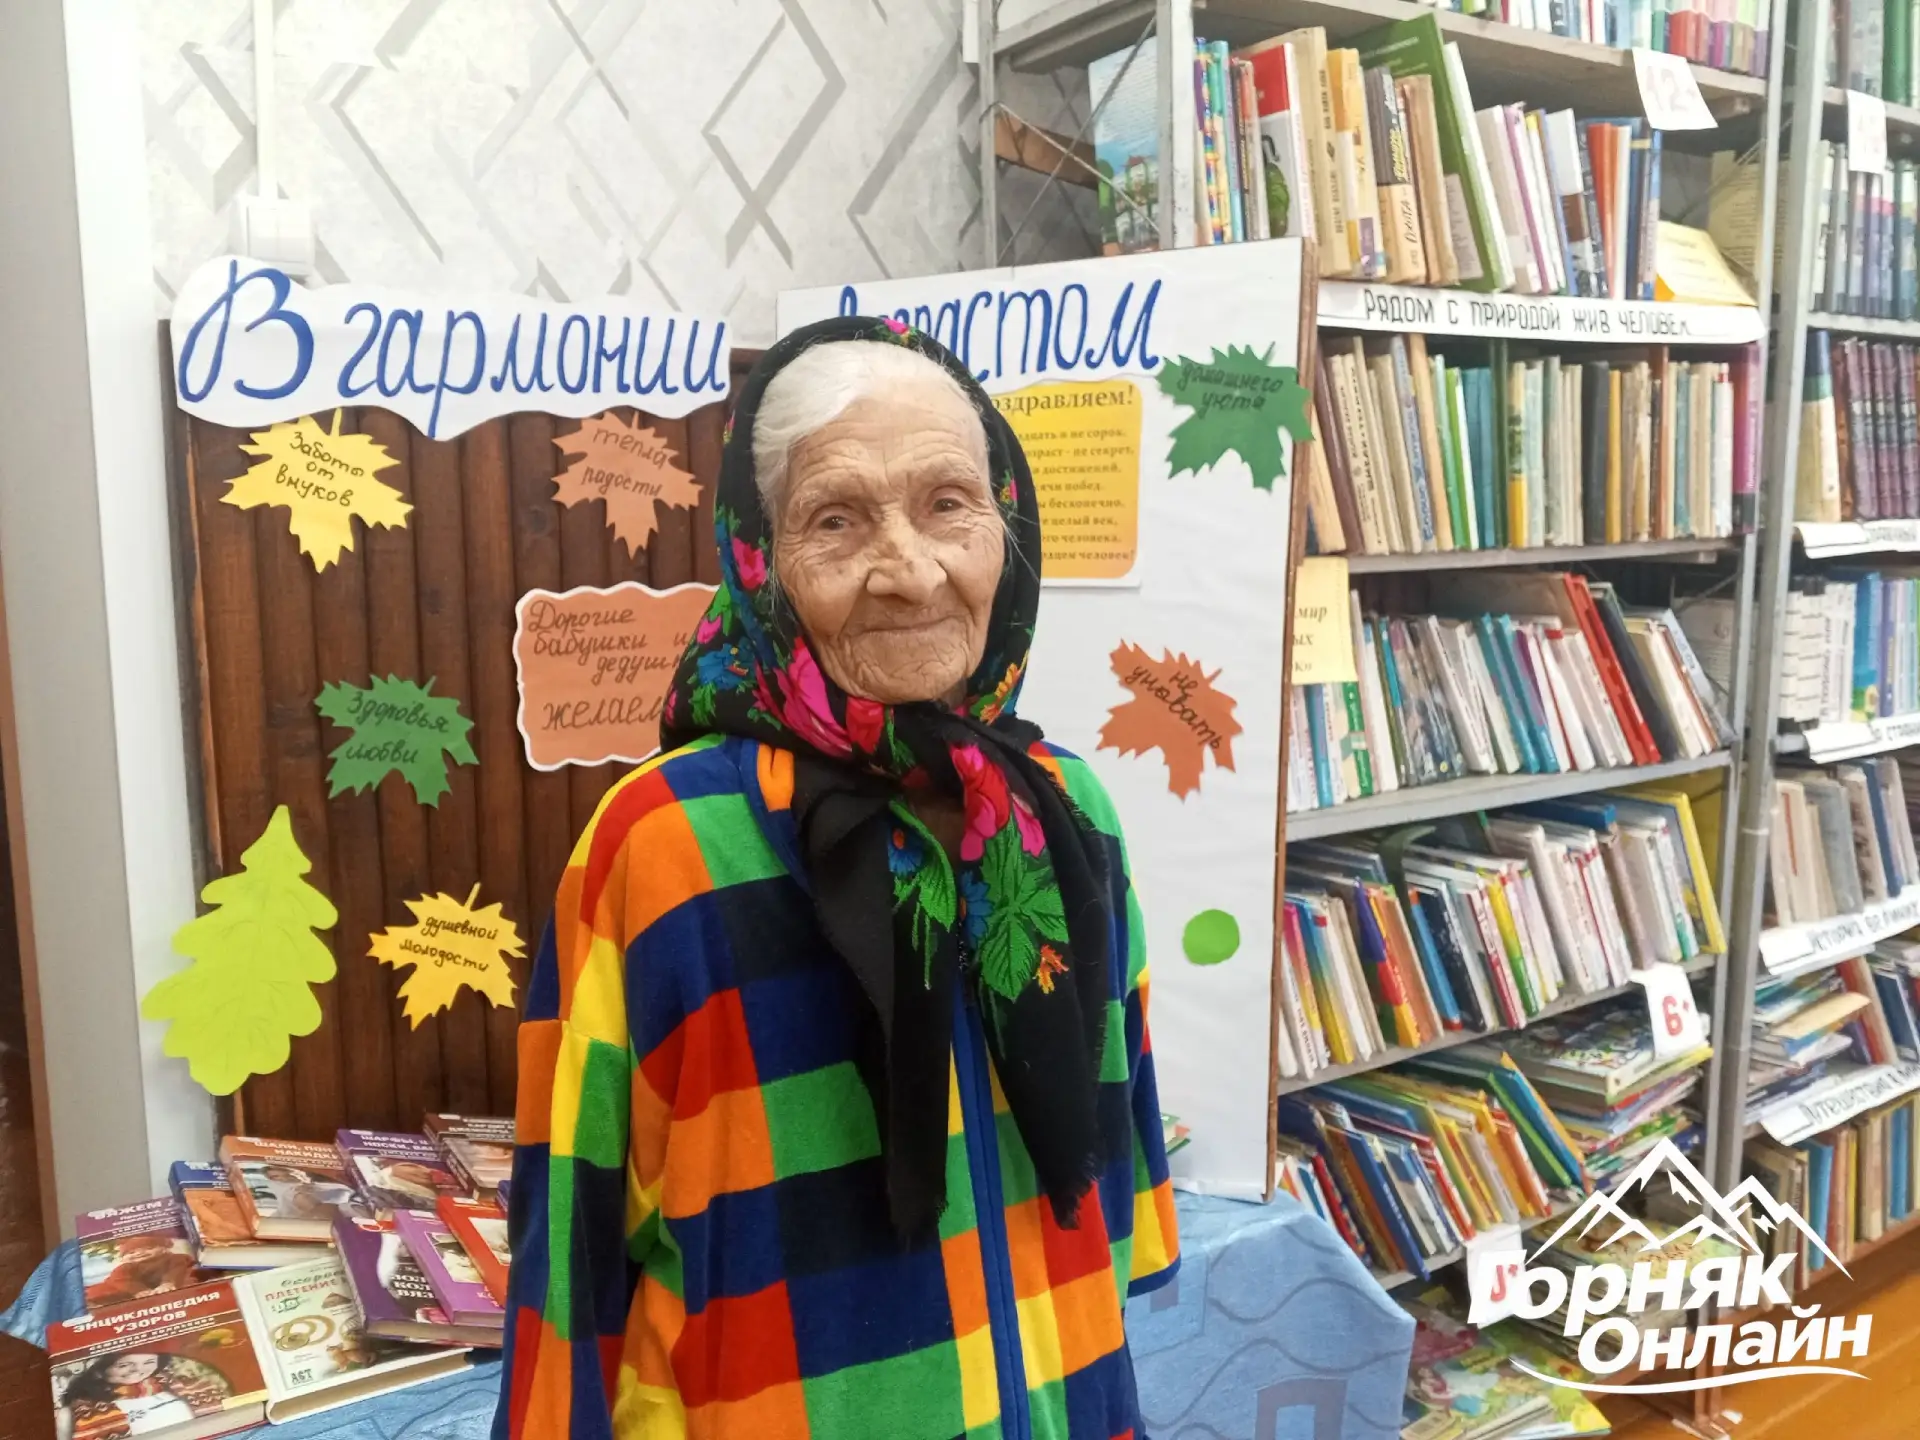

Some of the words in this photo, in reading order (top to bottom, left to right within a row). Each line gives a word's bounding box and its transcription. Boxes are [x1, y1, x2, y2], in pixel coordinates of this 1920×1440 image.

[1364, 289, 1434, 325] РЯДОМ
[1447, 299, 1459, 325] С
[1471, 301, 1560, 332] ПРИРОДОЙ
[1573, 308, 1609, 334] ЖИВ
[177, 259, 315, 403] В
[336, 301, 727, 439] гармонии
[993, 384, 1134, 417] оздравляем!
[1197, 391, 1267, 420] уюта
[275, 463, 354, 507] внуков
[306, 461, 335, 480] от
[580, 465, 663, 496] радости
[528, 599, 637, 633] Дорогие
[533, 628, 648, 665] бабушки
[594, 653, 680, 685] дедуш
[345, 739, 418, 764] любви
[424, 914, 499, 941] душевной
[399, 936, 489, 972] молодости
[265, 1278, 338, 1302] ПЛЕТЕНИЕ
[73, 1291, 220, 1333] ЭНЦИКЛОПЕДИЯ
[113, 1310, 187, 1334] УЗОРОВ
